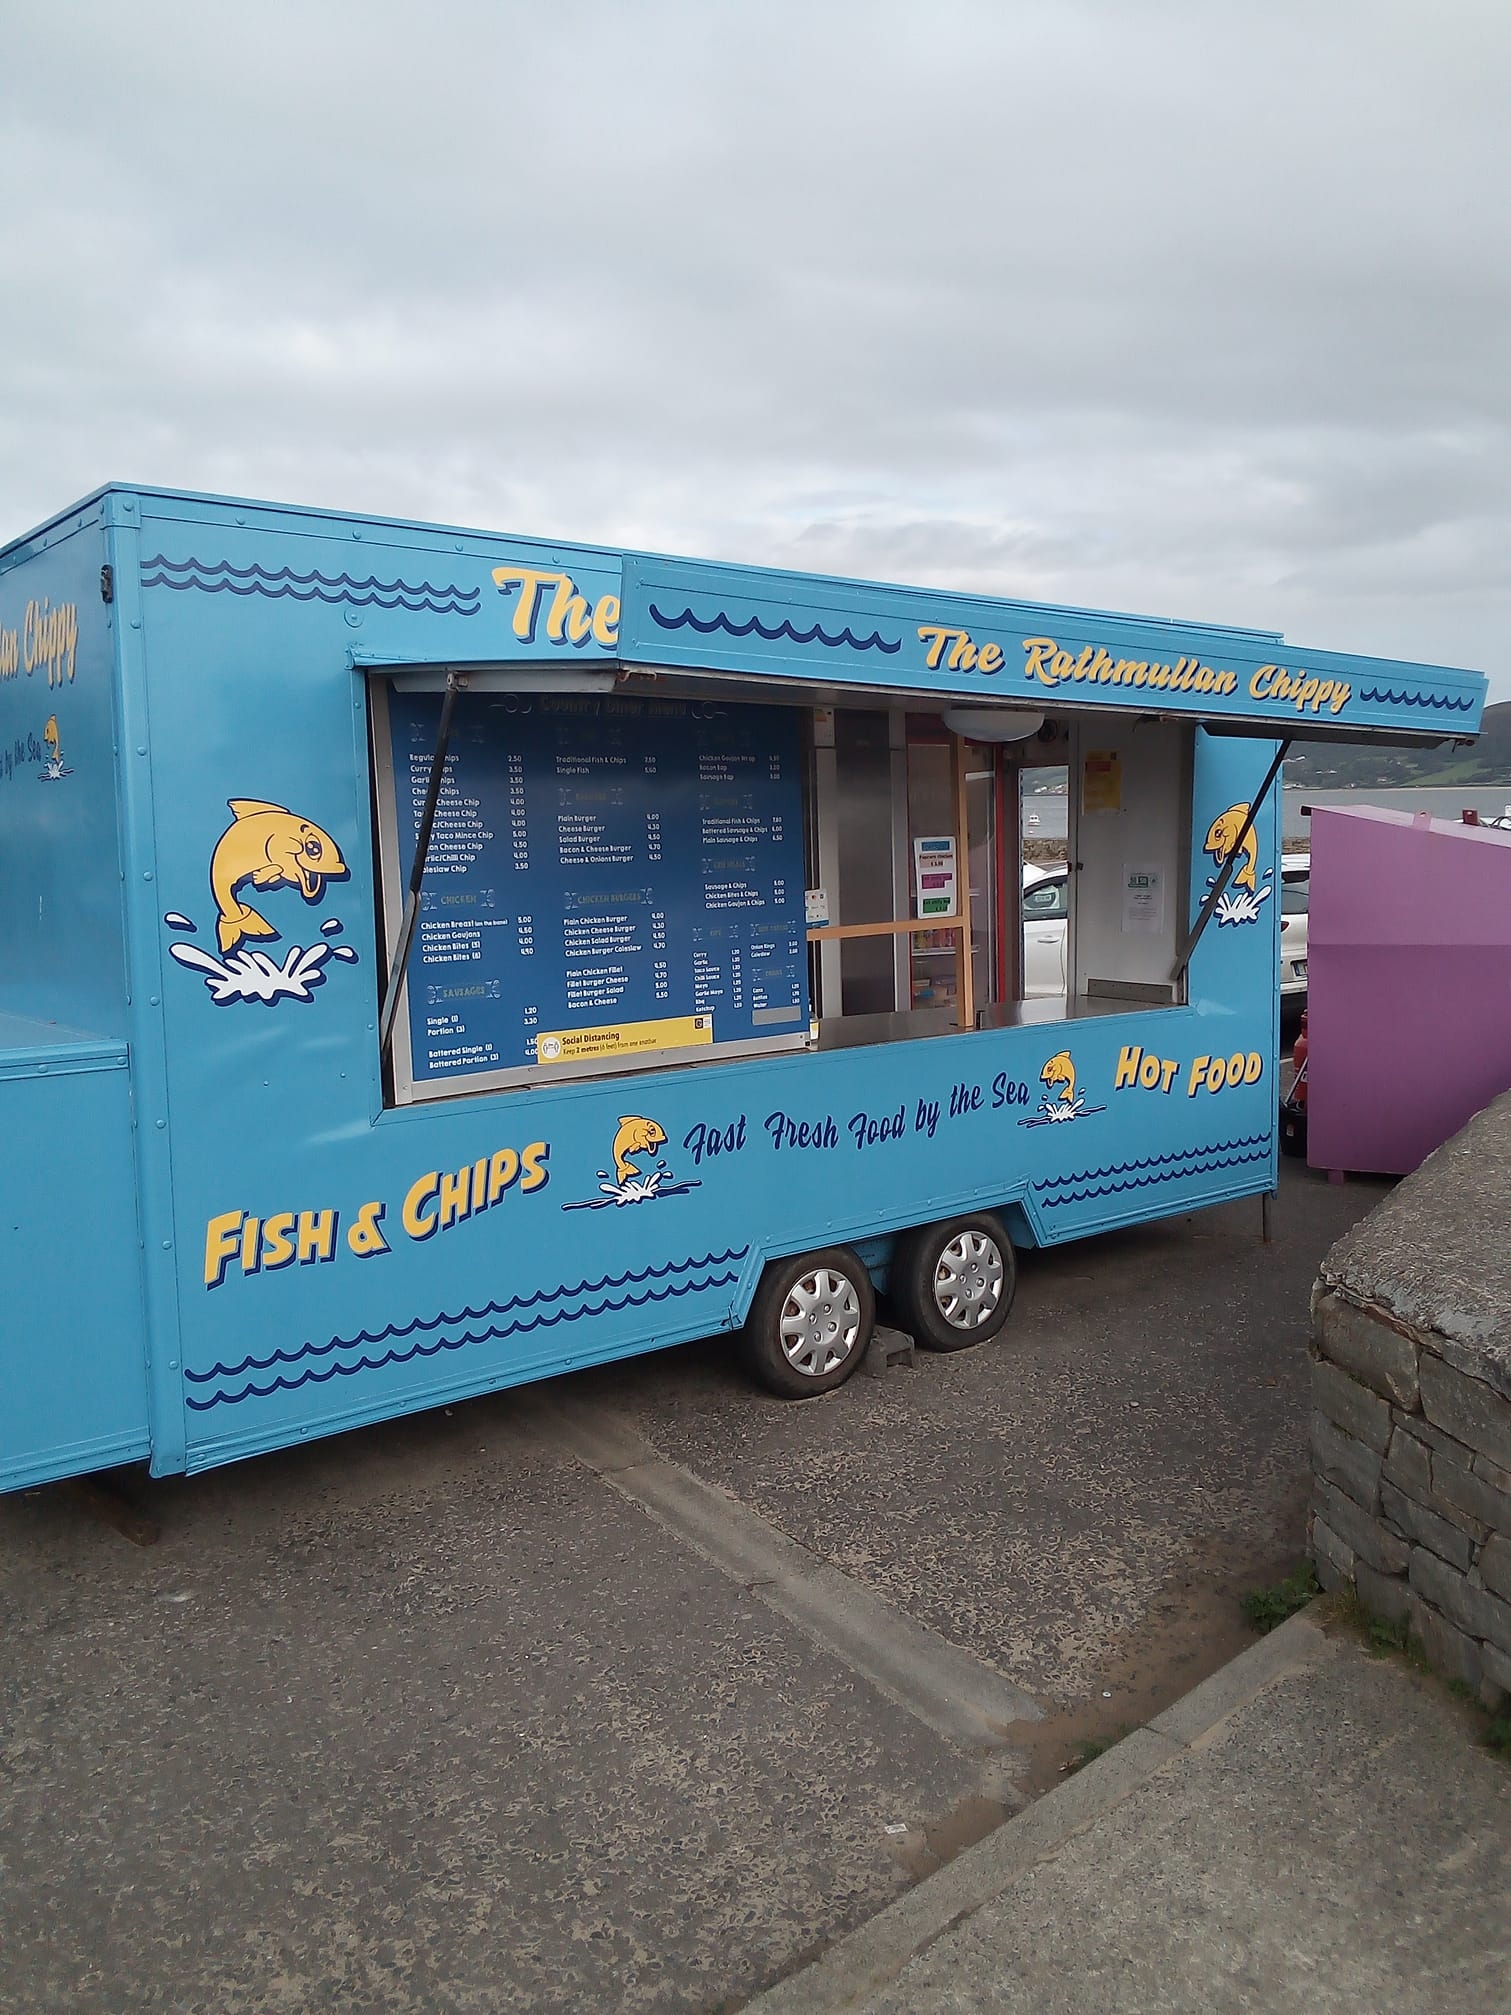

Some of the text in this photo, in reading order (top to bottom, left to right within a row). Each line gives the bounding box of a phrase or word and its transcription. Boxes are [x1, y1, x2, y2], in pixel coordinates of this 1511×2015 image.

[24, 595, 78, 691] Chippy
[918, 627, 1352, 714] The Rathmullan Chippy
[28, 732, 41, 762] Sea
[610, 757, 626, 765] Chips
[410, 765, 432, 773] Curry
[575, 815, 596, 823] Burger
[578, 836, 600, 844] Burger
[610, 845, 631, 853] Burger
[441, 896, 477, 904] CHICKEN
[421, 922, 450, 930] Chicken
[451, 920, 473, 928] Breast
[615, 925, 636, 933] Burger
[452, 931, 480, 939] Goujons
[423, 944, 451, 952] Chicken
[423, 953, 469, 963] Chicken Bites
[583, 979, 604, 987] Burger
[443, 986, 485, 997] SAUSAGES
[427, 1018, 449, 1026] Single
[427, 1027, 453, 1036] Portion
[563, 1032, 619, 1045] Social Distancing
[429, 1048, 461, 1058] Battered
[429, 1058, 461, 1069] Battered
[463, 1056, 488, 1064] Portion
[1114, 1046, 1264, 1098] HOT FOOD
[683, 1072, 1029, 1165] Fast Fresh Food by the Sea
[204, 1142, 551, 1291] FISH & CHIPS
